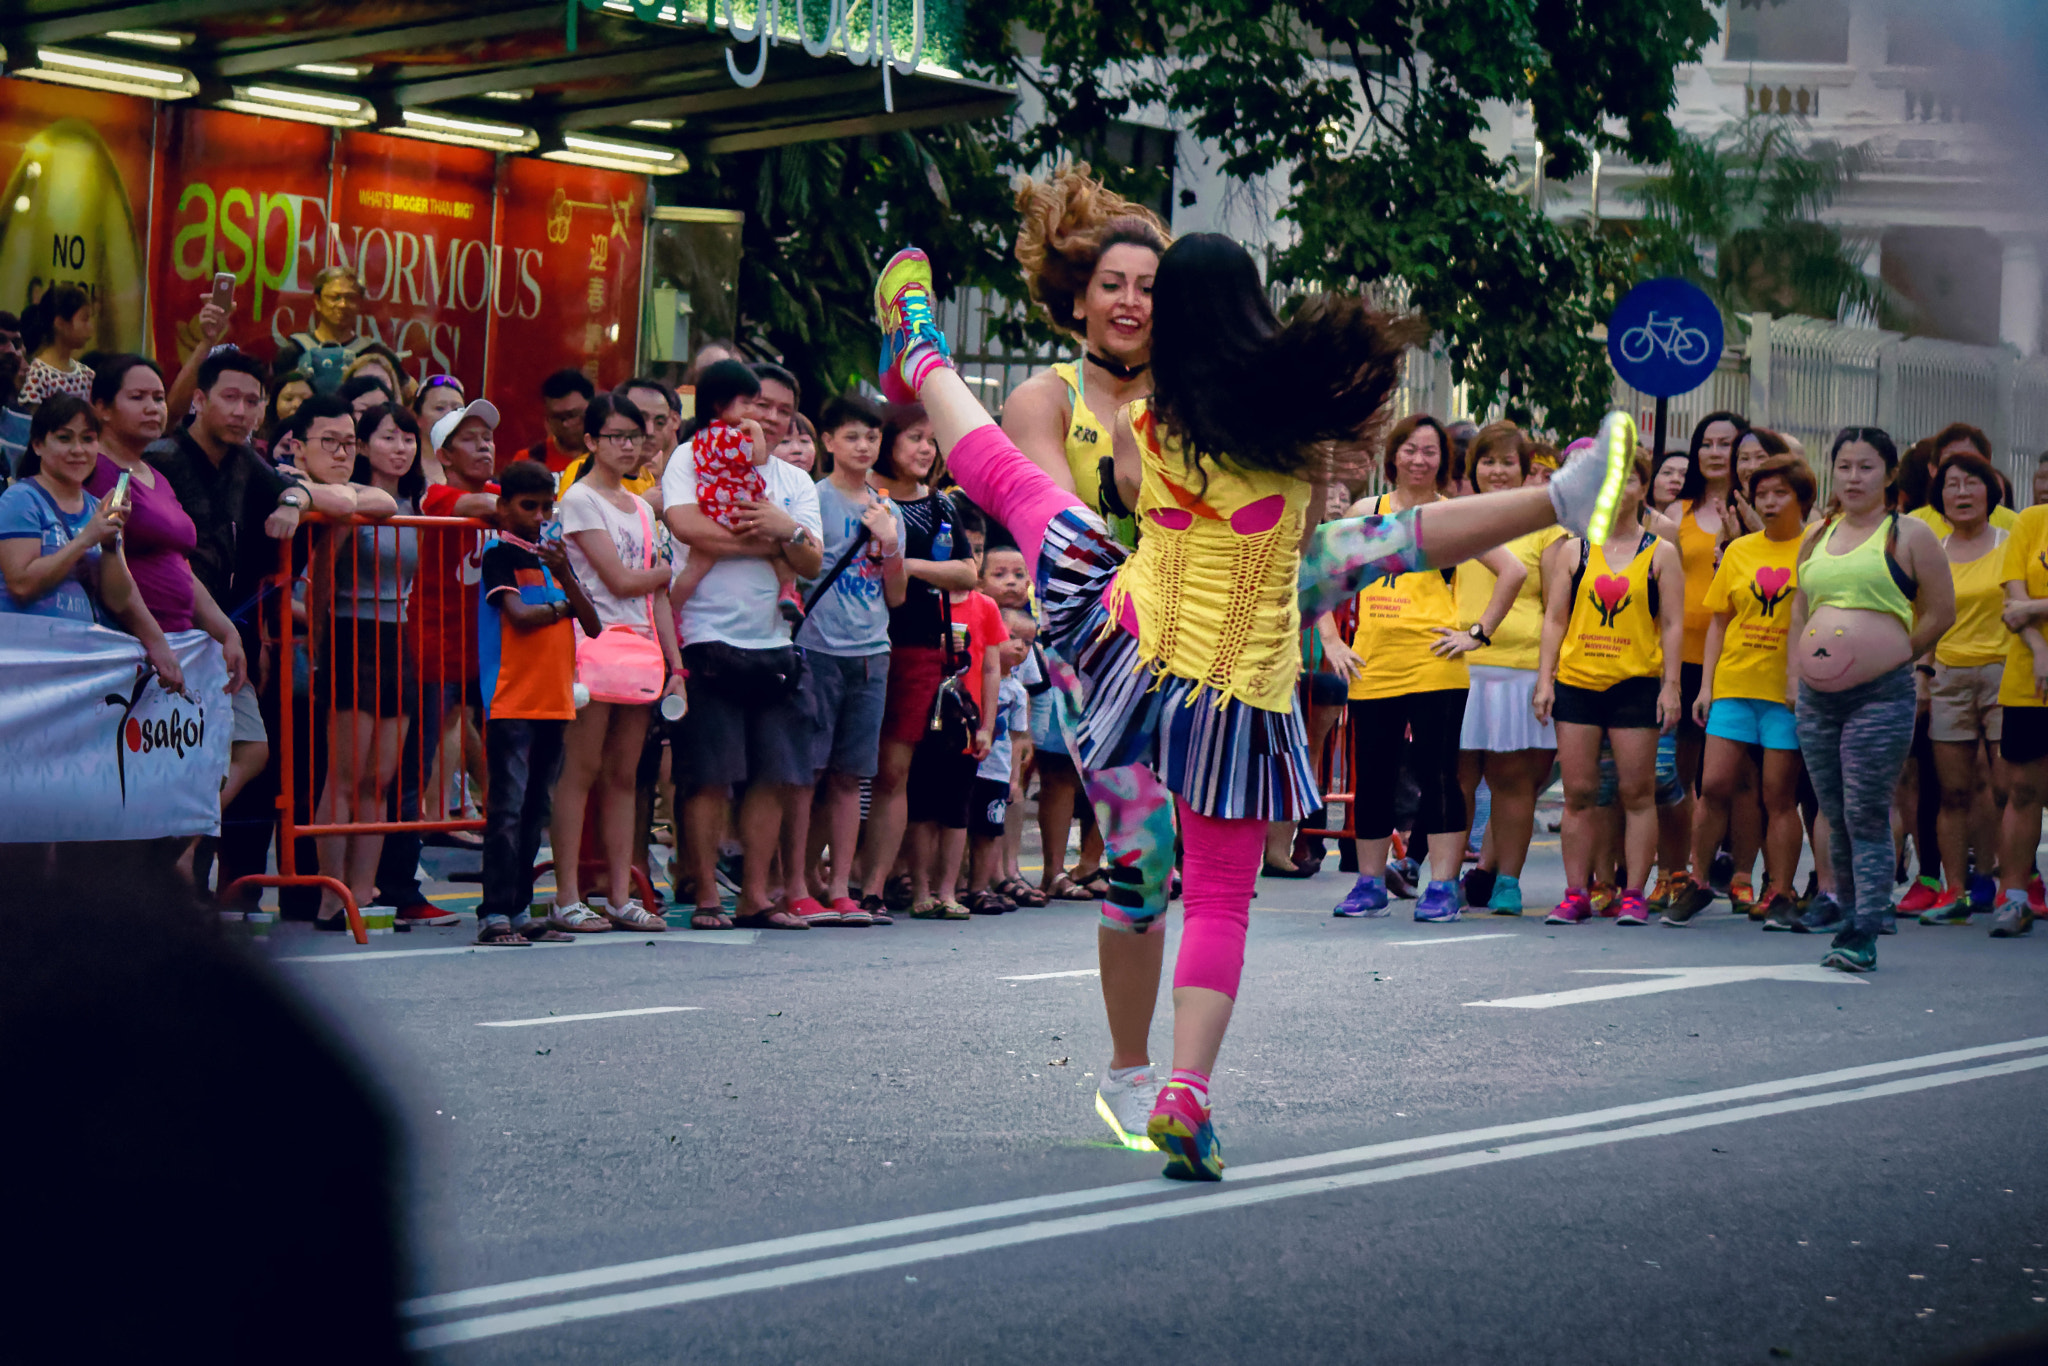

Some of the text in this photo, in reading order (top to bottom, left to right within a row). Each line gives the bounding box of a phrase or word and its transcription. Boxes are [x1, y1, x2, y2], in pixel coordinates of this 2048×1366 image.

[359, 189, 392, 209] WHAT'S
[392, 193, 428, 214] BIGGER
[430, 198, 452, 216] THAN
[52, 233, 85, 270] NO
